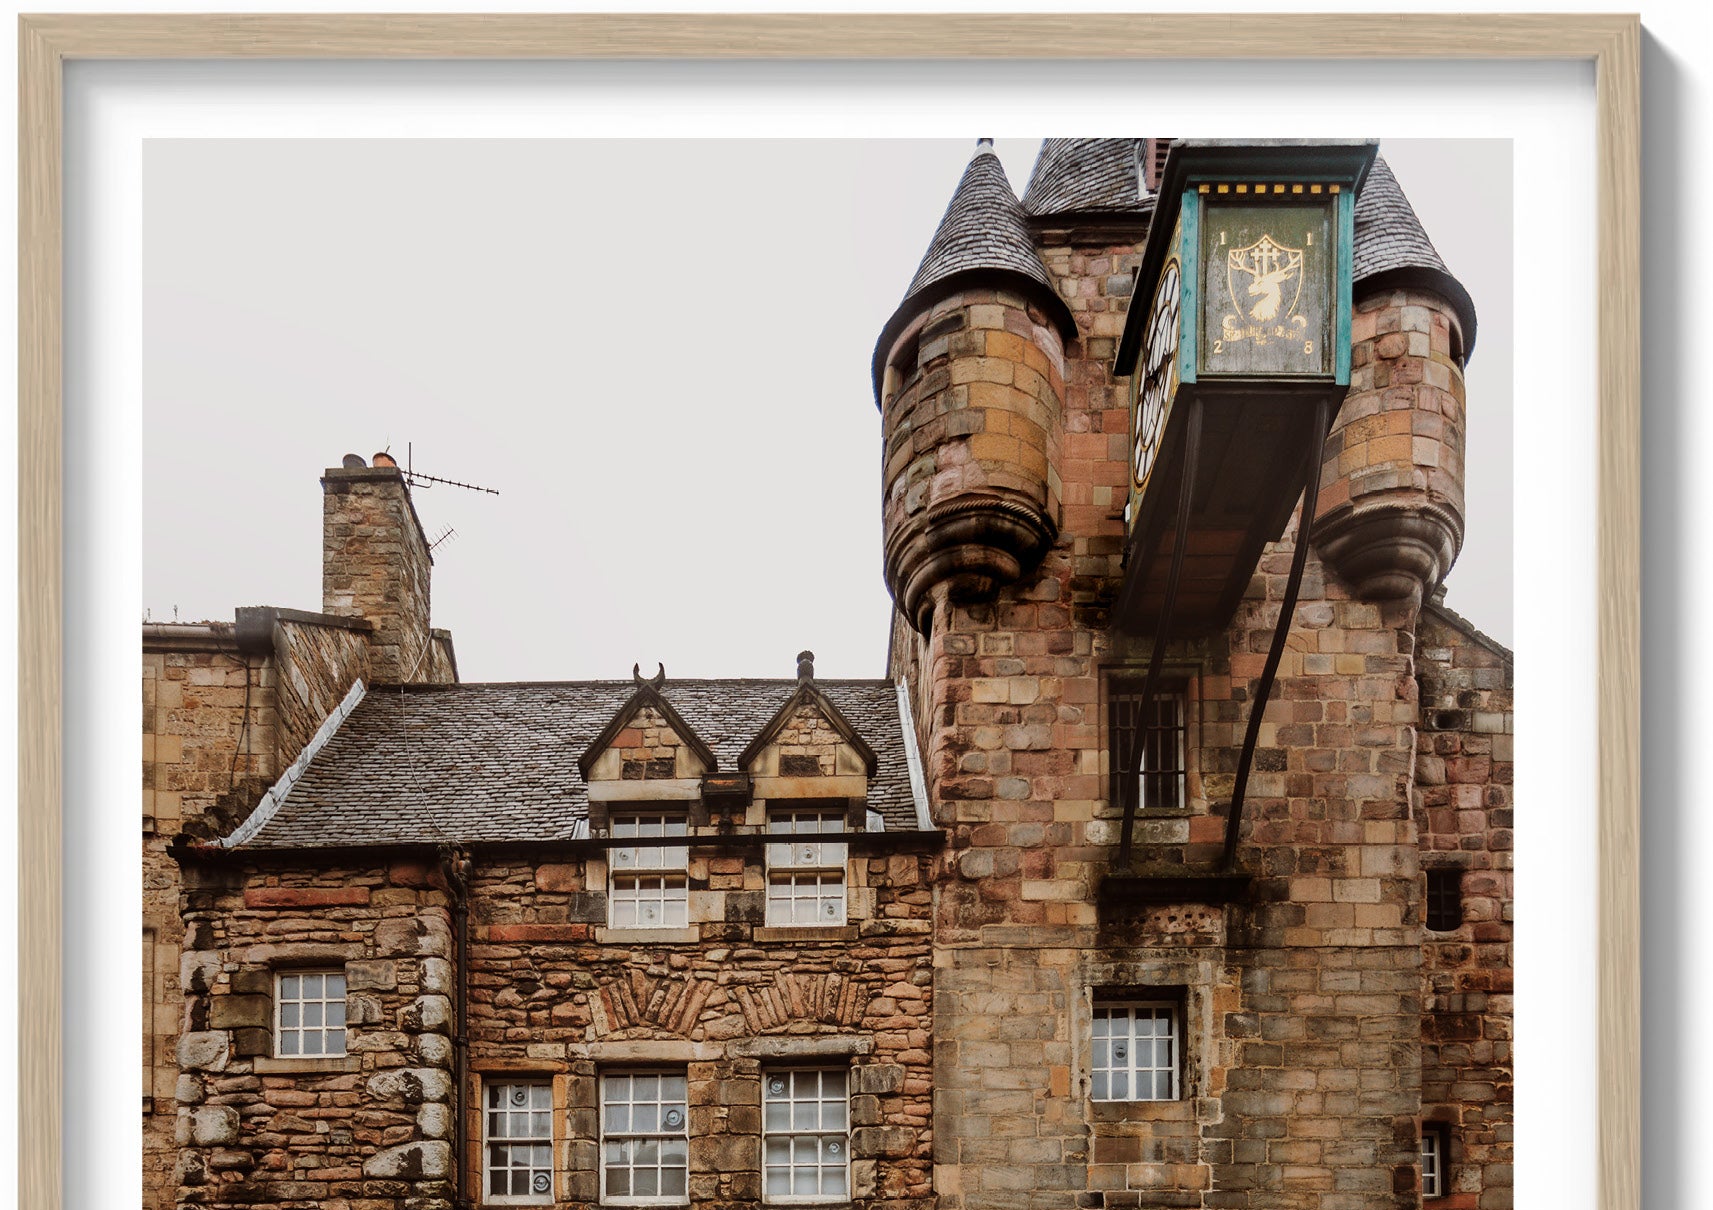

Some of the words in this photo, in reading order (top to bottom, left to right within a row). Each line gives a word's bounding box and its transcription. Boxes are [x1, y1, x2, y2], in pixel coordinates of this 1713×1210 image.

[1220, 231, 1226, 246] 1
[1306, 232, 1313, 246] 1
[1213, 340, 1223, 354] 2
[1303, 340, 1313, 355] 8
